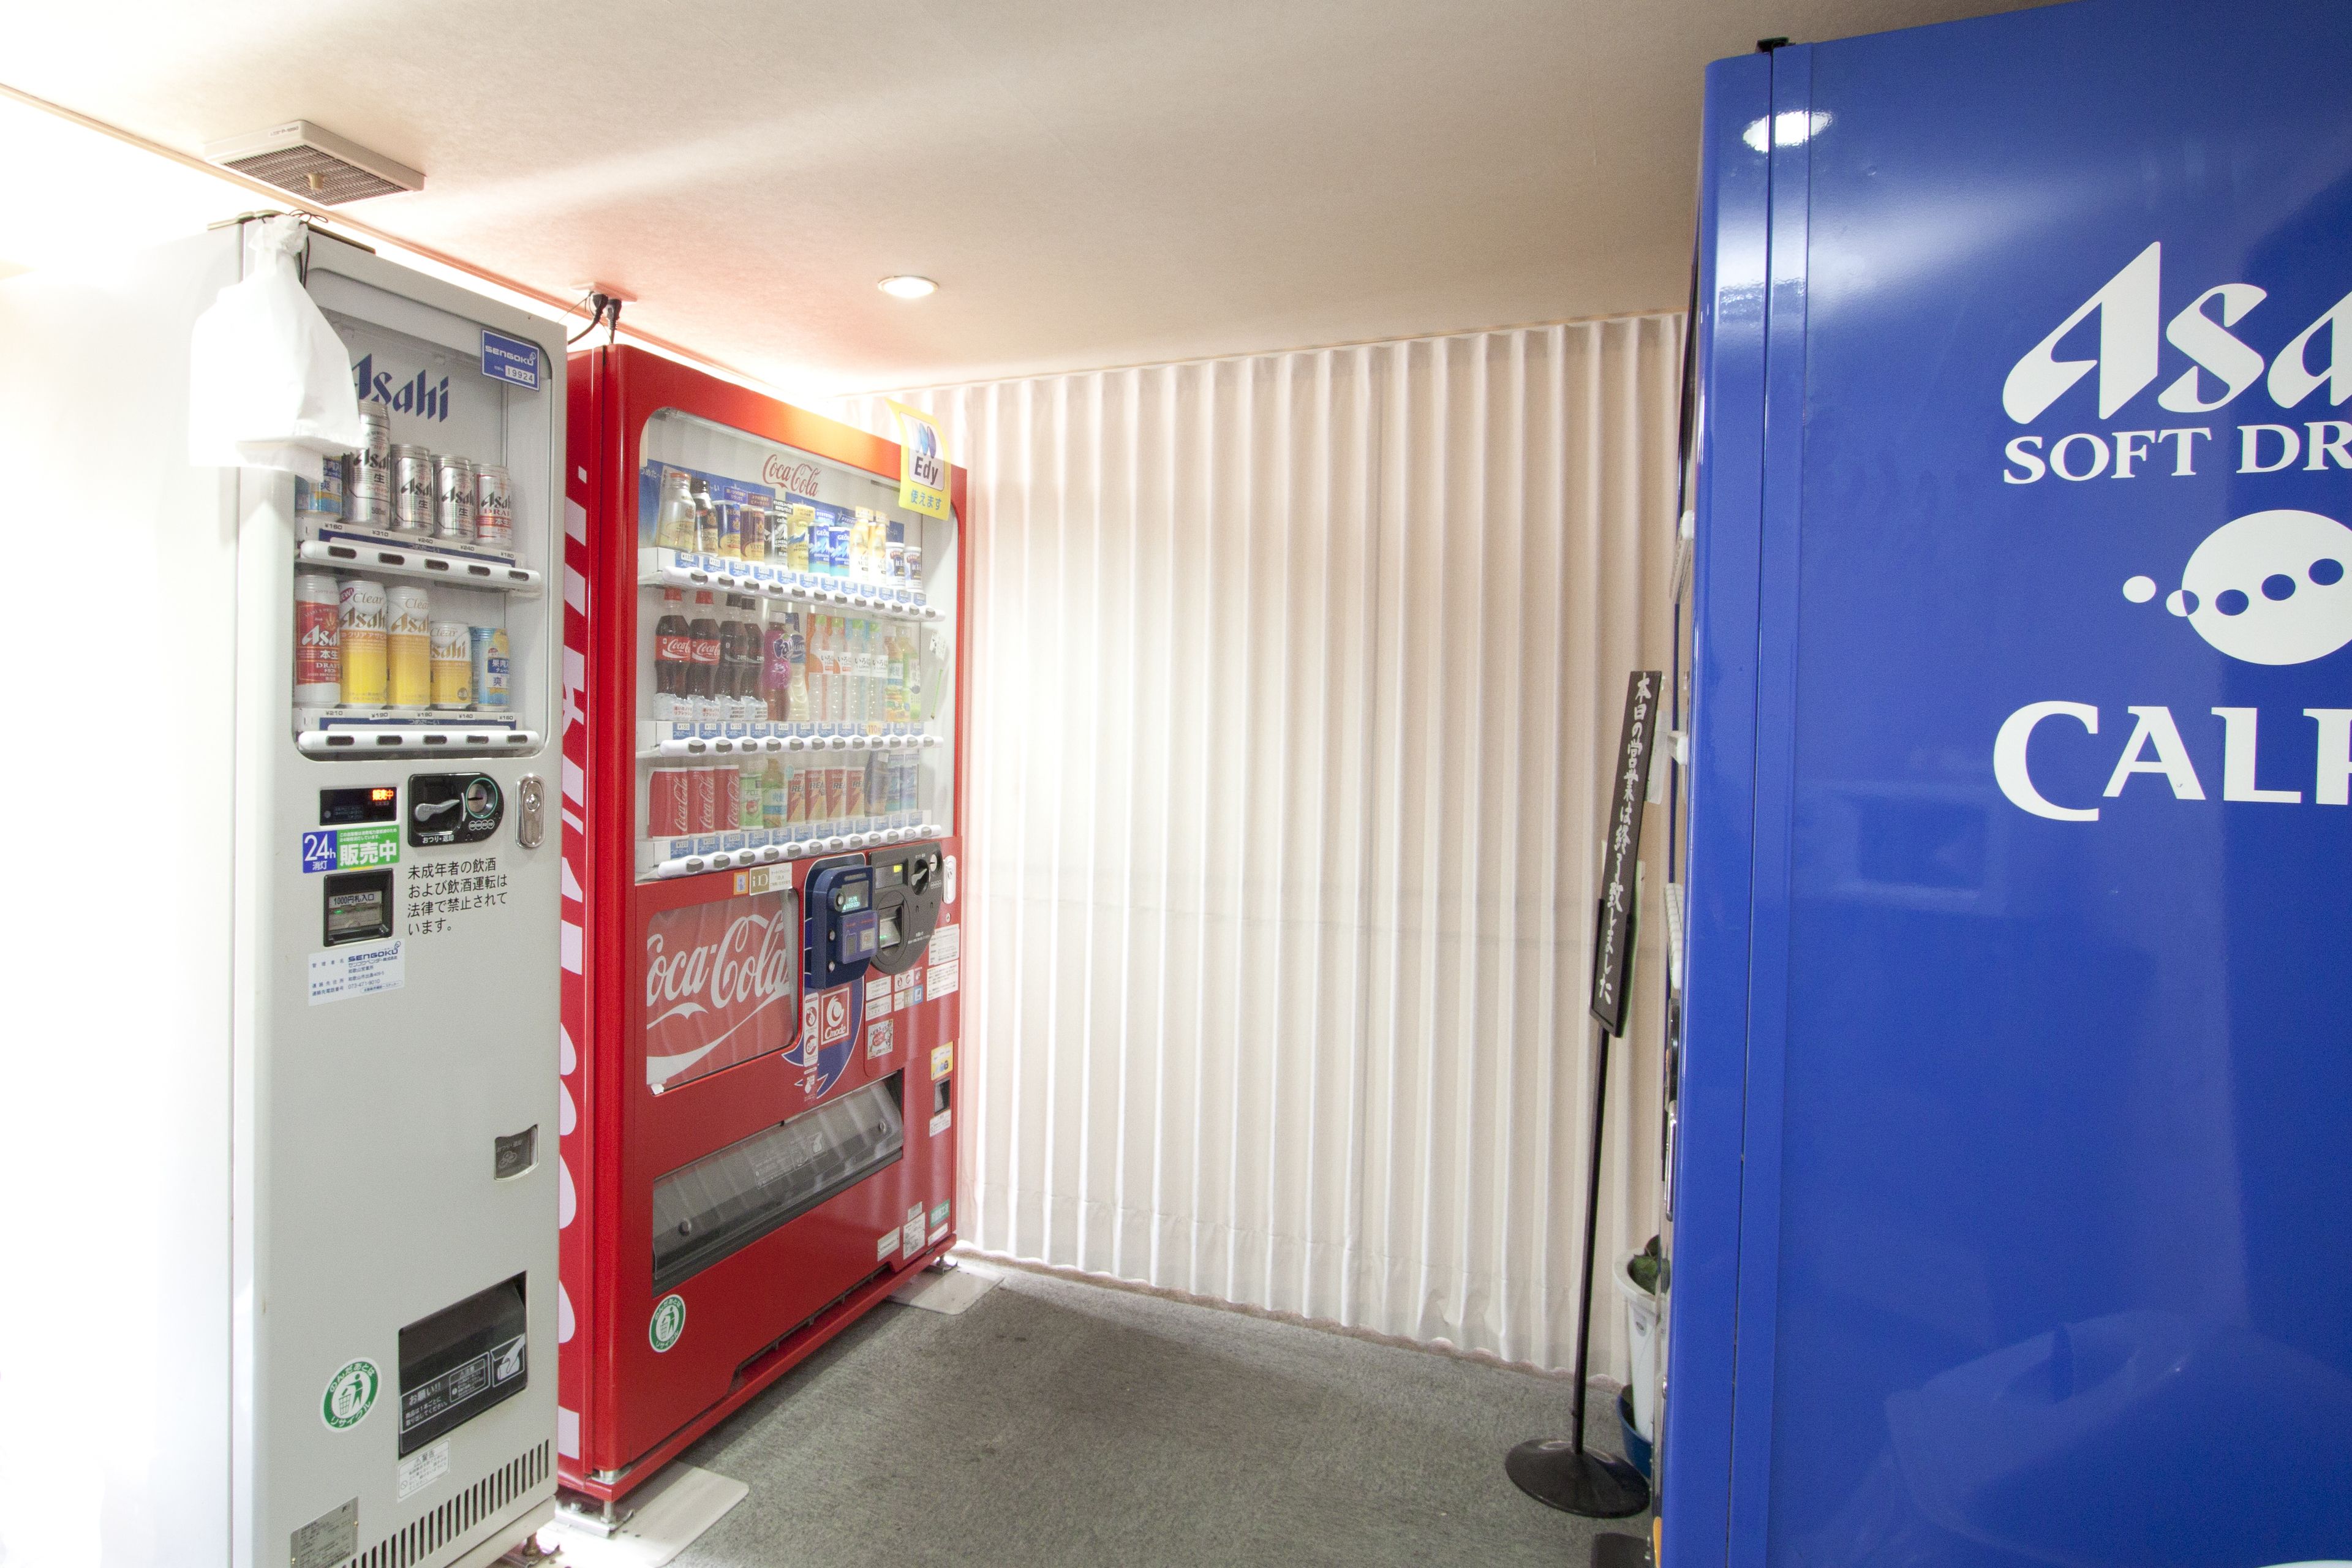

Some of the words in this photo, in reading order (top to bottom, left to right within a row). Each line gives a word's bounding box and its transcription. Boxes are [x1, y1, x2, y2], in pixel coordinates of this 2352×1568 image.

[485, 345, 534, 366] SENGOKU
[508, 368, 533, 382] 19924
[2003, 426, 2211, 484] SOFT
[374, 473, 385, 484] 生
[763, 454, 822, 497] Coca-Cola
[914, 456, 938, 486] Edy
[418, 499, 428, 509] 生
[911, 489, 942, 511] 使えます
[459, 508, 468, 517] 生
[353, 592, 384, 604] Clear
[492, 676, 502, 687] 爽
[372, 789, 393, 801] 販売中
[304, 834, 336, 861] 24h
[340, 840, 397, 867] 販売中
[312, 860, 328, 870] 消灯
[407, 858, 496, 881] 未成年者の飲酒
[408, 874, 508, 899] および飲酒運転は
[753, 874, 768, 888] iD
[334, 894, 375, 905] 1000円札入口
[407, 892, 508, 919] 法律で禁止されて
[408, 918, 451, 936] います。
[348, 949, 399, 963] SENGOKU
[824, 1023, 846, 1040] Cmode
[330, 1363, 375, 1393] のんだあとは
[331, 1401, 371, 1427] リサイクル
